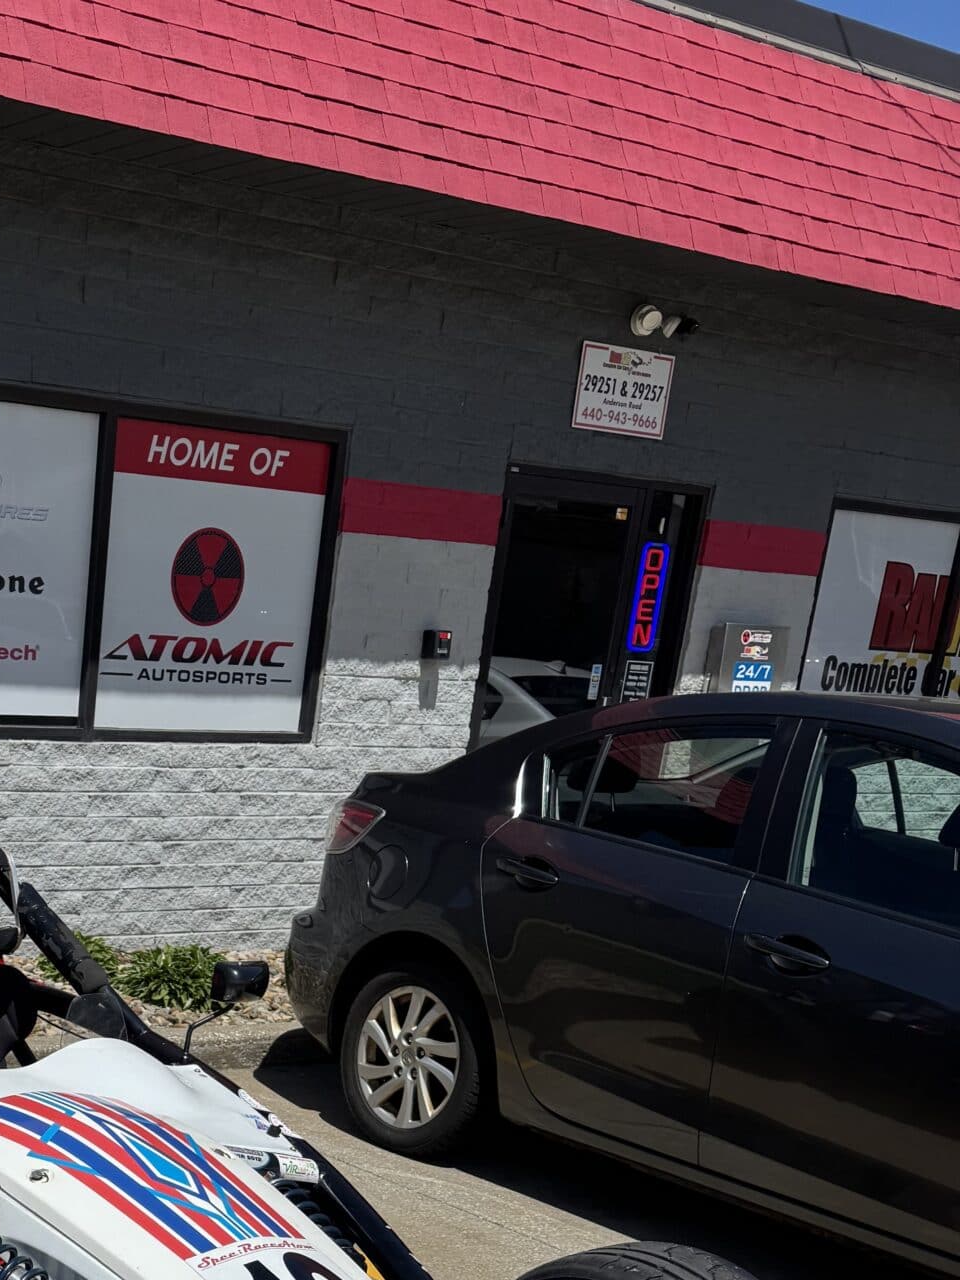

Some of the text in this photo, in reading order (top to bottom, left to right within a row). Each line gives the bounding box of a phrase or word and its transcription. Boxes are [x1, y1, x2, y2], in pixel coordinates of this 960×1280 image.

[584, 374, 664, 402] 29251 & 29257
[582, 406, 657, 429] 440-943-9666
[147, 434, 290, 477] HOME OF
[631, 548, 665, 646] OPEN
[103, 633, 294, 667] ATOMIC
[137, 669, 268, 686] AUTOSPORTS
[736, 664, 772, 679] 24/7
[821, 655, 918, 696] Complete
